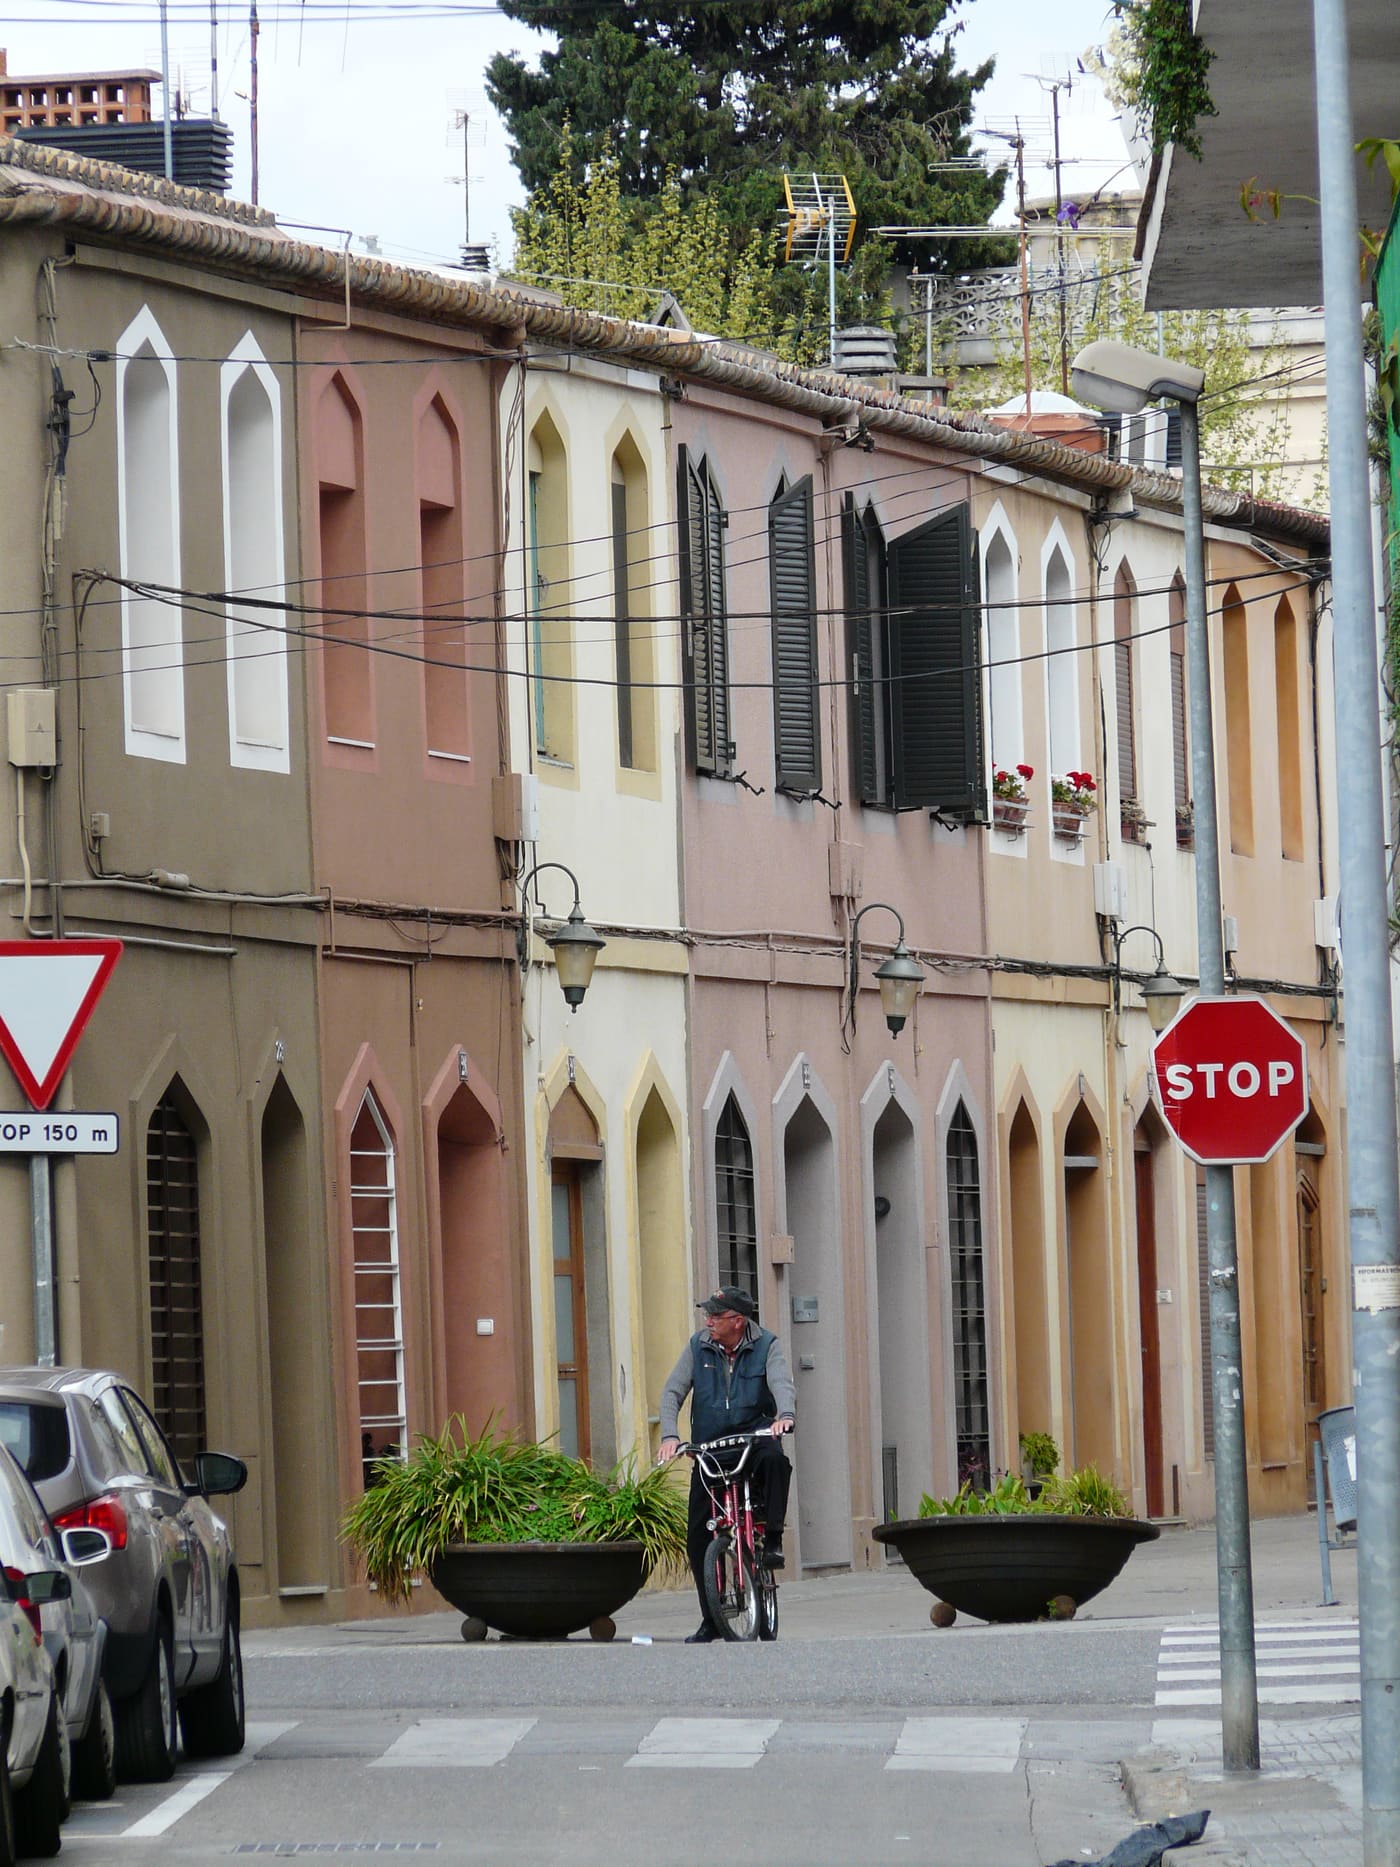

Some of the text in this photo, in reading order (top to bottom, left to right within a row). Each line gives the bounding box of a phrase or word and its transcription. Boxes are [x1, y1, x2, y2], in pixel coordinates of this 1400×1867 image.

[1166, 1061, 1295, 1100] STOP
[0, 1124, 108, 1142] OP 150 m
[700, 1436, 746, 1450] ORBEA
